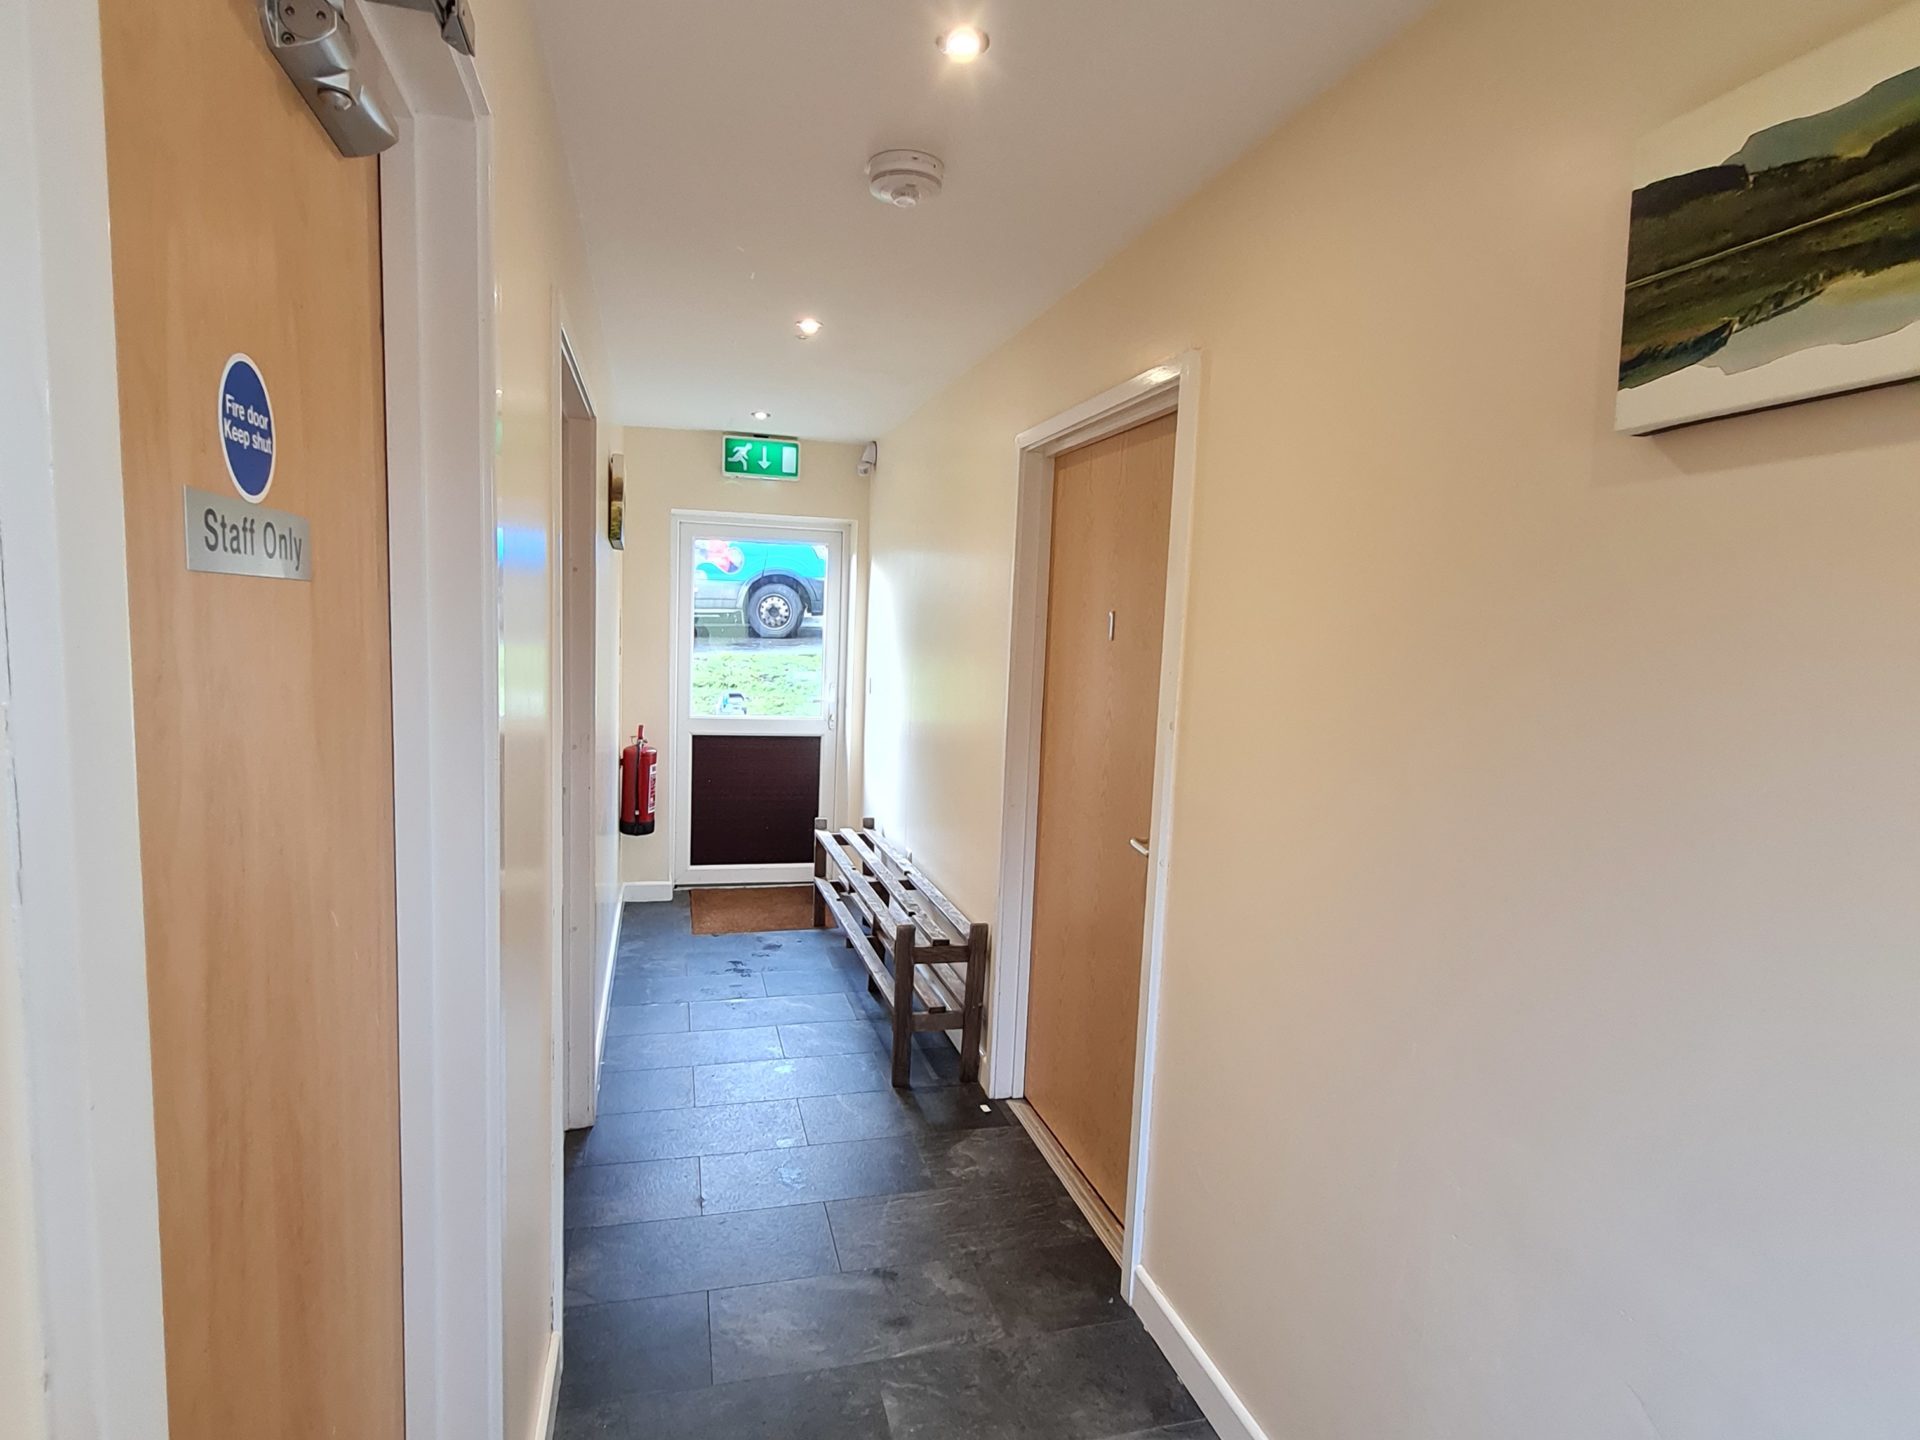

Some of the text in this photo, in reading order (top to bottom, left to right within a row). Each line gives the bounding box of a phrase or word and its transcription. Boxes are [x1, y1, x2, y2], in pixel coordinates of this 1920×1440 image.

[225, 394, 269, 430] Fire door
[223, 419, 273, 454] Keep shut
[204, 508, 302, 571] Staff Only
